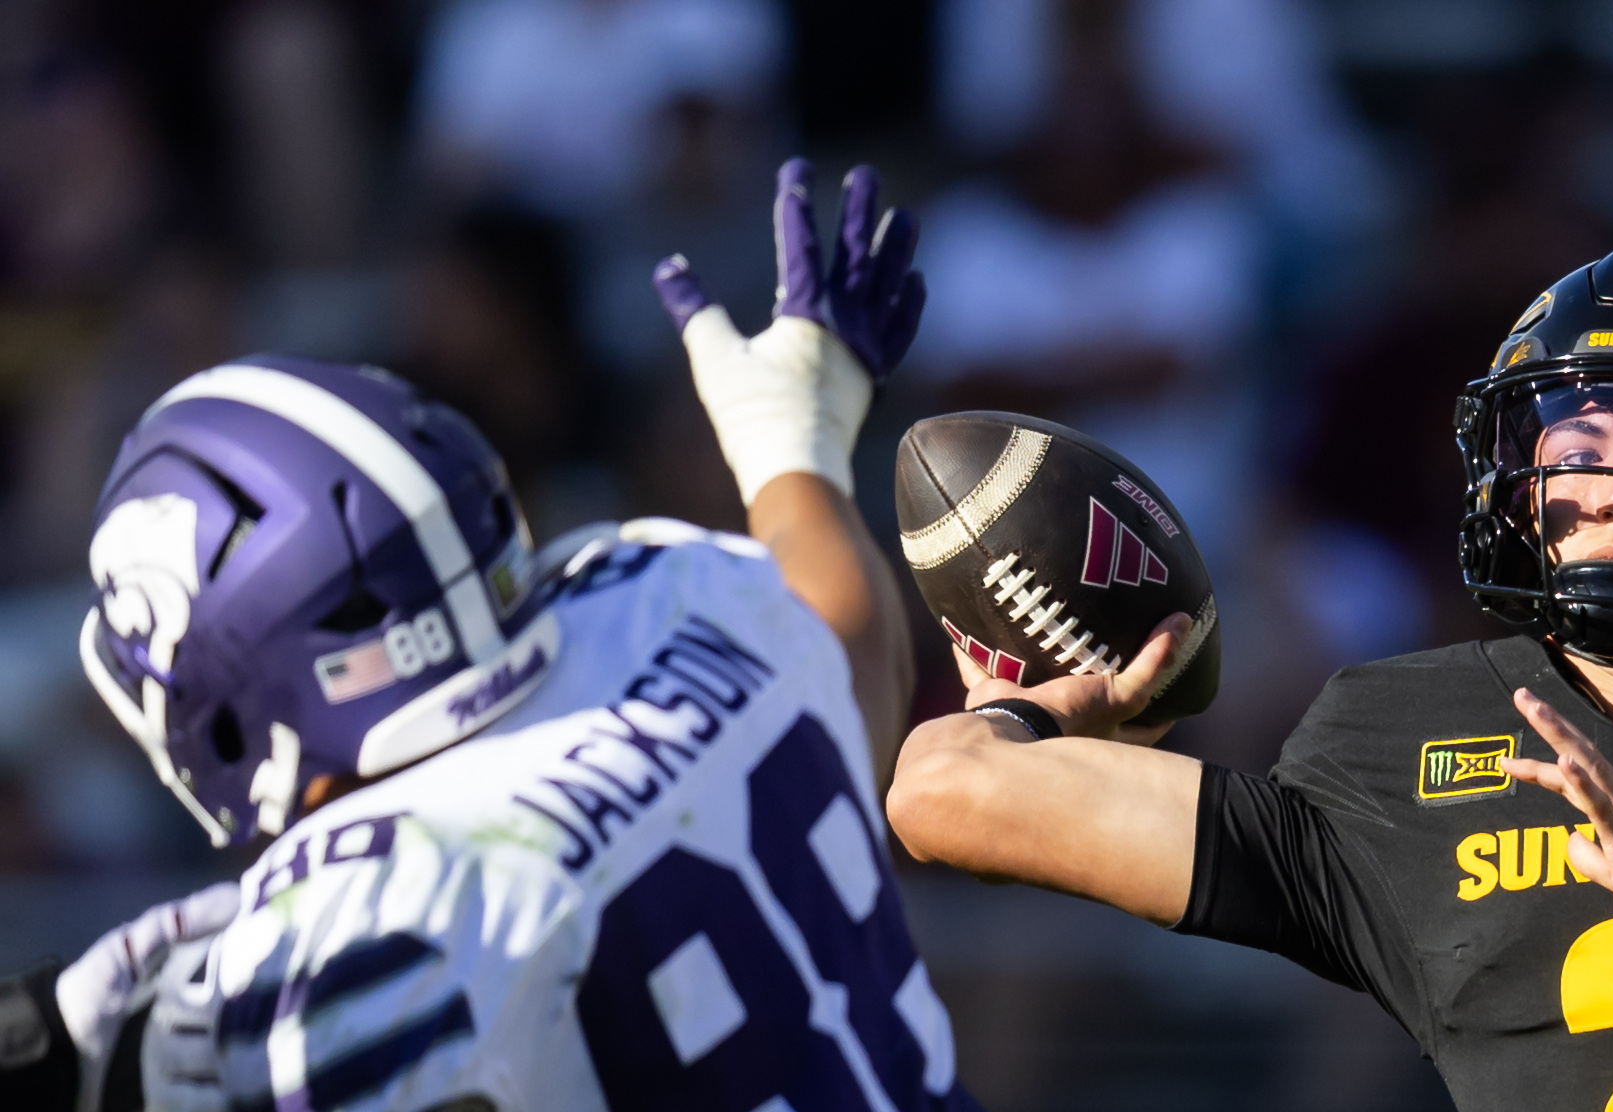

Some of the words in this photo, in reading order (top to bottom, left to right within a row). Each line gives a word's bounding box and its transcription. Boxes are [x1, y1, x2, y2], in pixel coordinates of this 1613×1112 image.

[1112, 474, 1181, 539] DIME
[383, 607, 456, 680] 88
[513, 614, 777, 873] JACKSON
[1456, 822, 1602, 901] SUN
